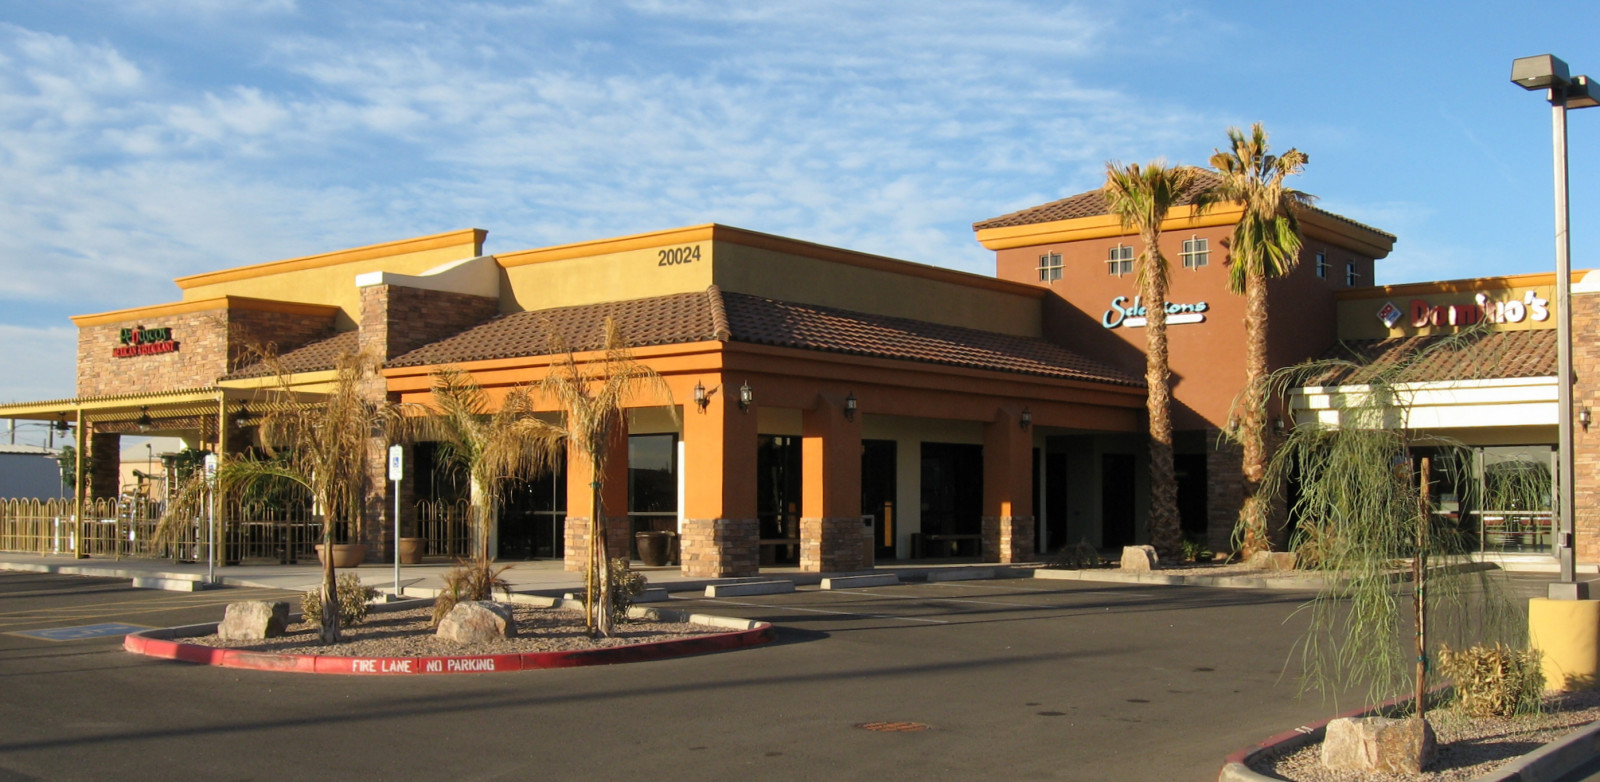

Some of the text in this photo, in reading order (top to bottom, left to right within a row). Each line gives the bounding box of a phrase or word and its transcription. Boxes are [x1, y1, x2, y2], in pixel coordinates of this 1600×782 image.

[658, 245, 701, 266] 20024
[1410, 290, 1548, 327] Domino's
[138, 340, 175, 356] RESTAURANT
[352, 658, 494, 673] FIRE LANE NO PARKING
